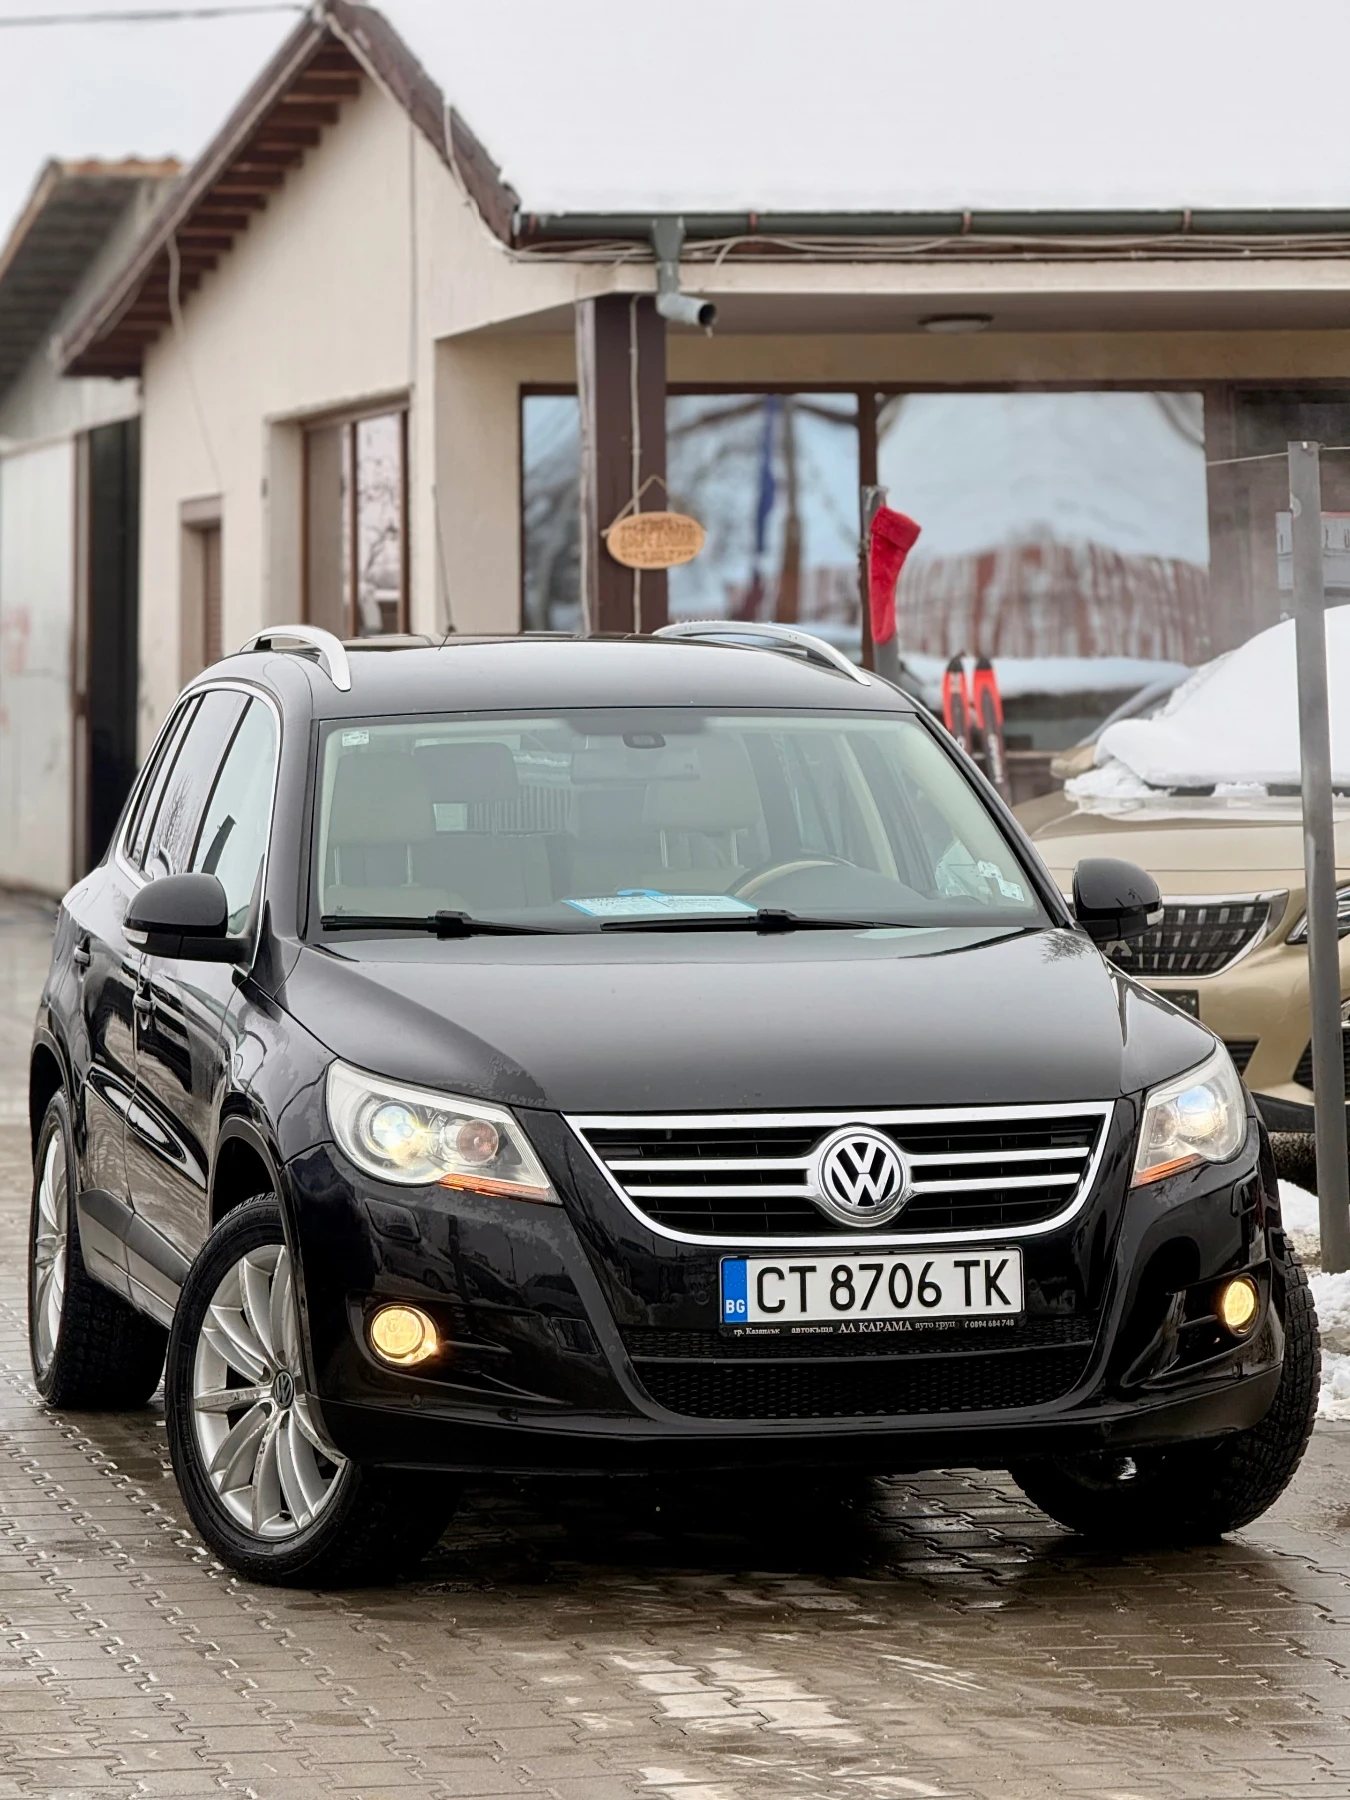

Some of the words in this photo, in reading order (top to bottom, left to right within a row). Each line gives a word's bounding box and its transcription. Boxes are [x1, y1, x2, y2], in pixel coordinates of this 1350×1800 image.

[825, 1136, 901, 1212] VW
[756, 1266, 817, 1313] CT
[829, 1261, 942, 1311] 8706
[953, 1258, 1012, 1307] TK
[725, 1300, 745, 1314] BG
[791, 1326, 834, 1334] автокъща
[839, 1322, 856, 1334] АЛ
[859, 1320, 913, 1333] КАРАМА
